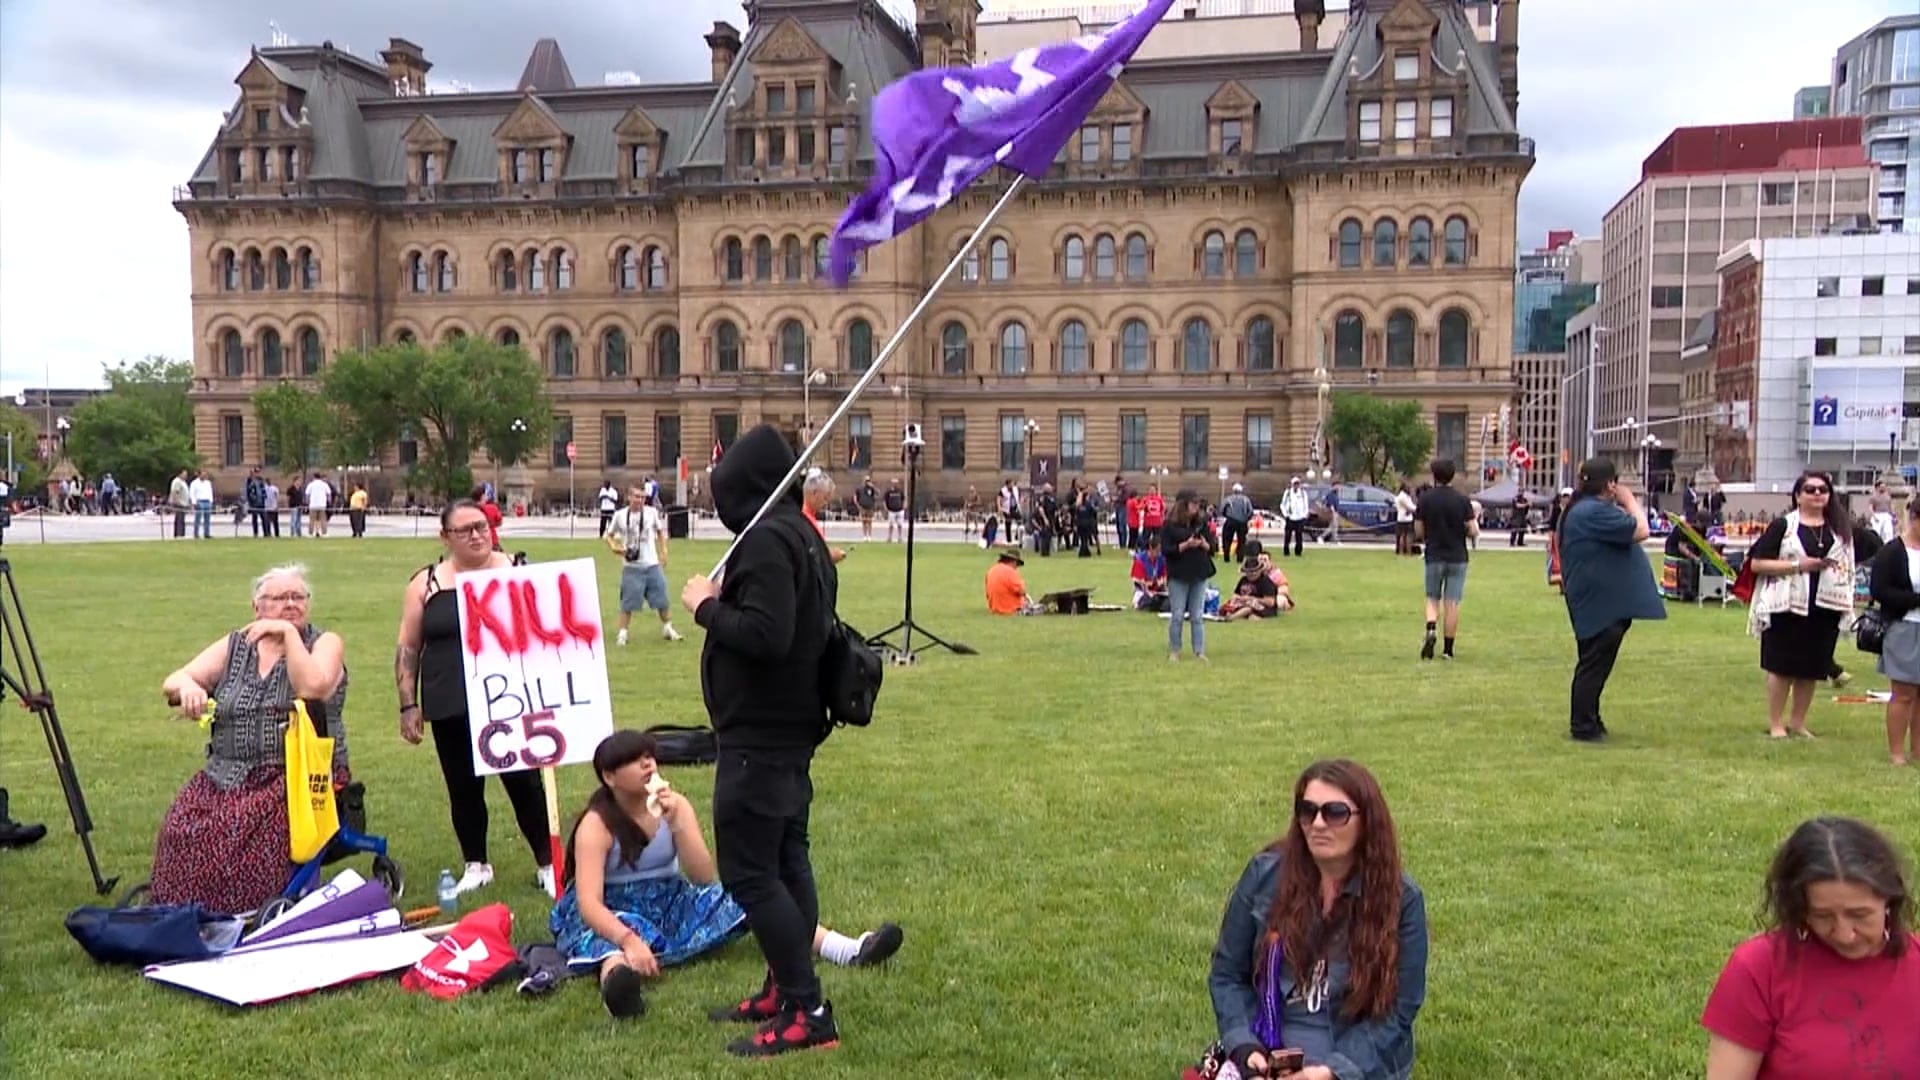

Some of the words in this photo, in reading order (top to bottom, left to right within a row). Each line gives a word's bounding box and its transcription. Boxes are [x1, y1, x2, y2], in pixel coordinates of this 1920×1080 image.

[462, 573, 598, 655] KILL
[483, 671, 592, 724] BILL
[477, 710, 567, 770] C5
